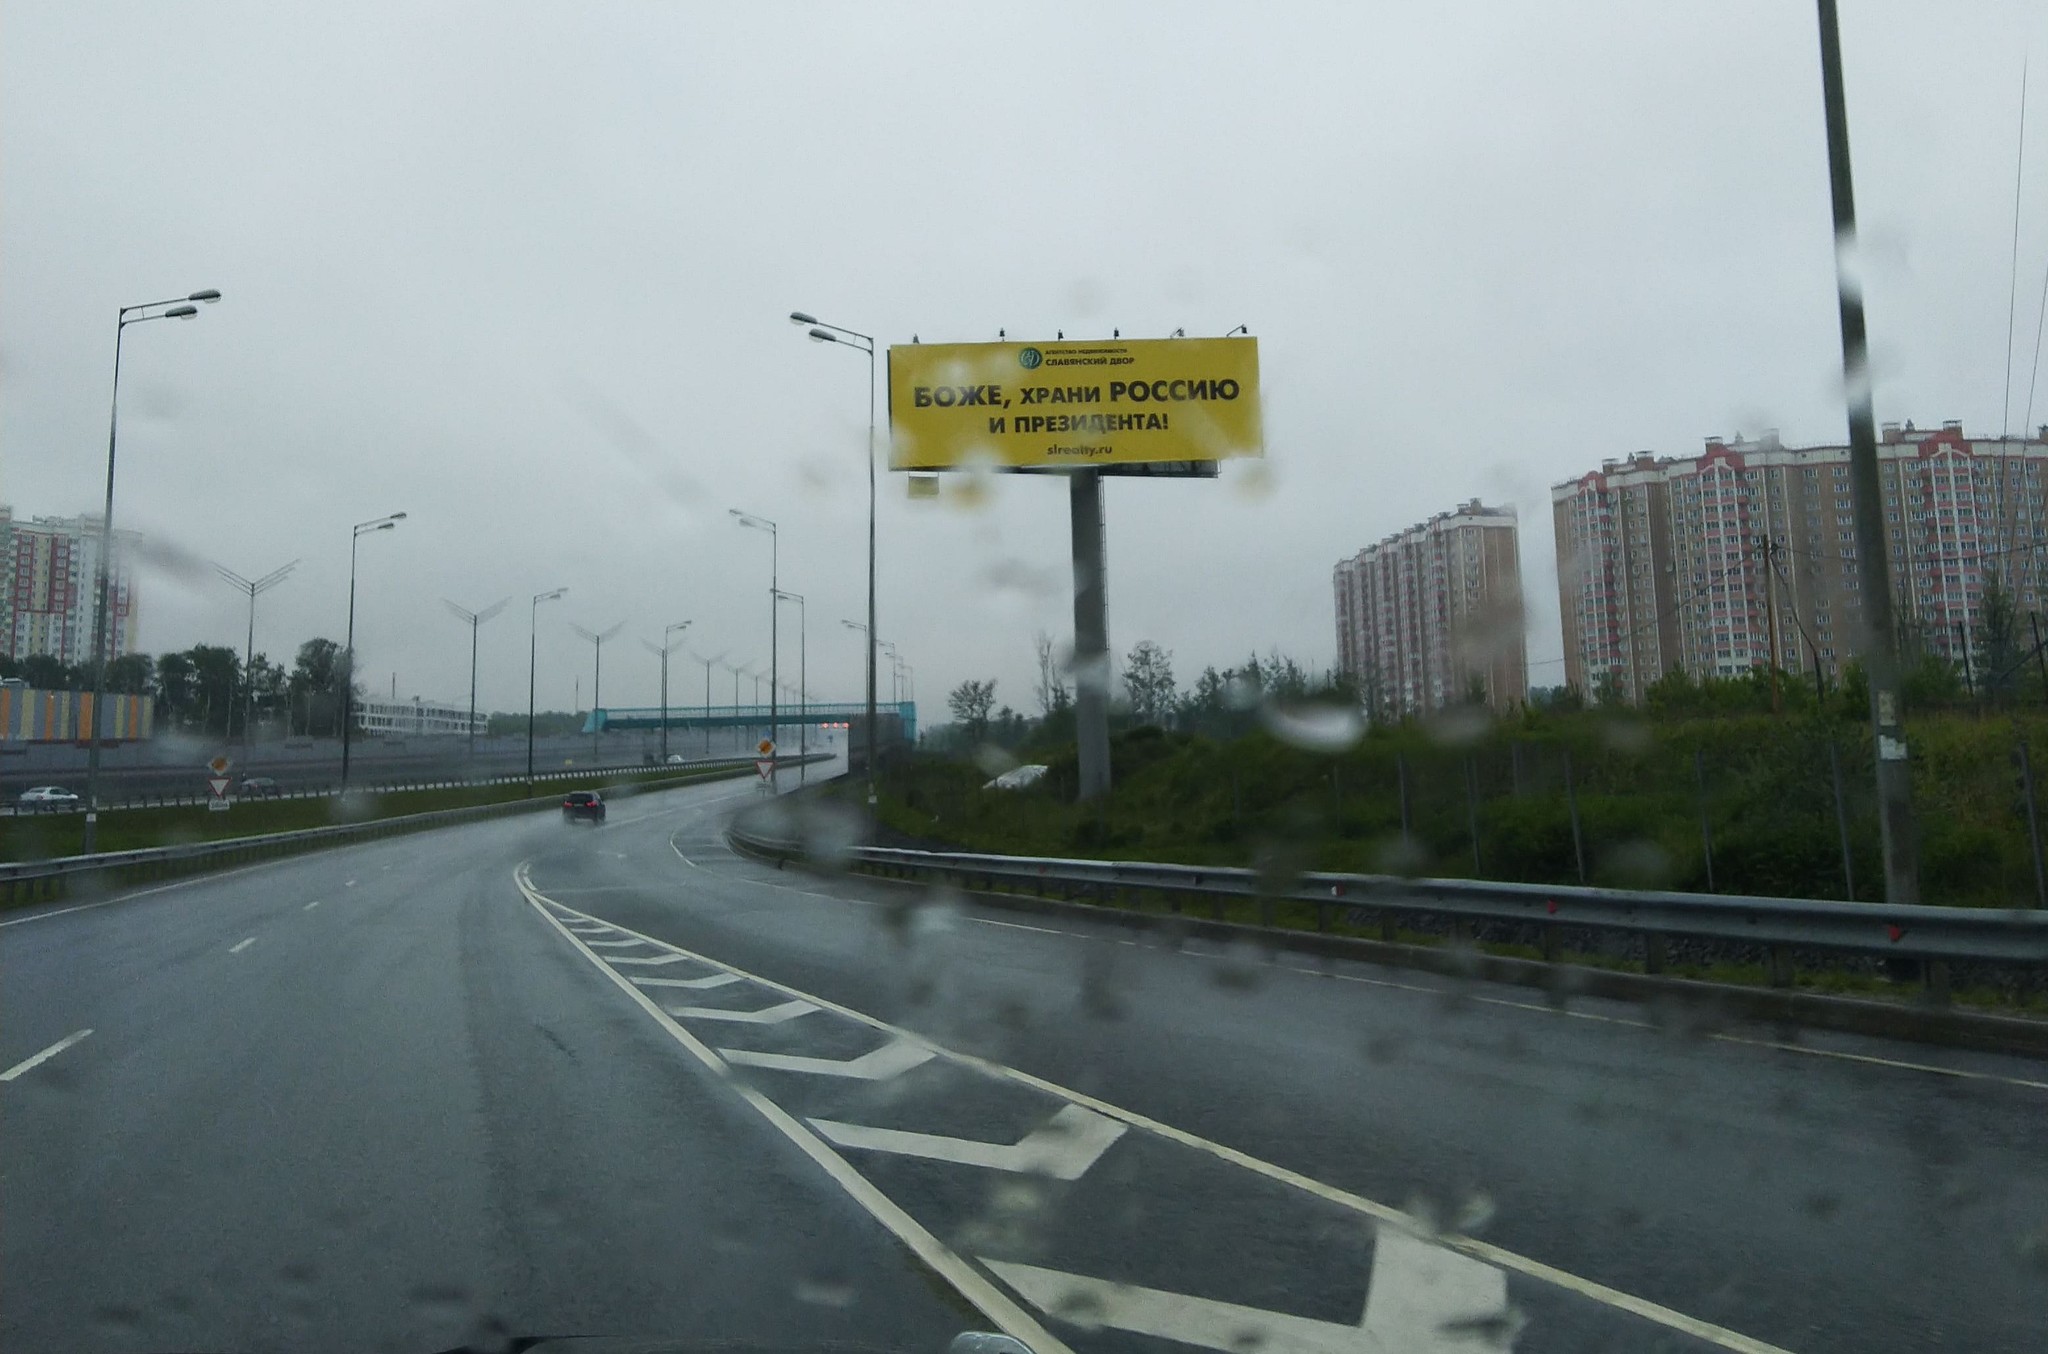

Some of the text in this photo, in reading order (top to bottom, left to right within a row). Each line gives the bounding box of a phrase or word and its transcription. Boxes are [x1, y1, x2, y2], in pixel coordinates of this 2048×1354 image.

[1045, 356, 1135, 367] СЛАВЯНСКИЙ ДВОР
[914, 379, 1240, 409] БОЖЕ, ХРАНИ РОССИЮ
[989, 413, 1169, 435] И ПРЕЗИДЕНТА!
[1047, 443, 1112, 457] slrealty.ru
